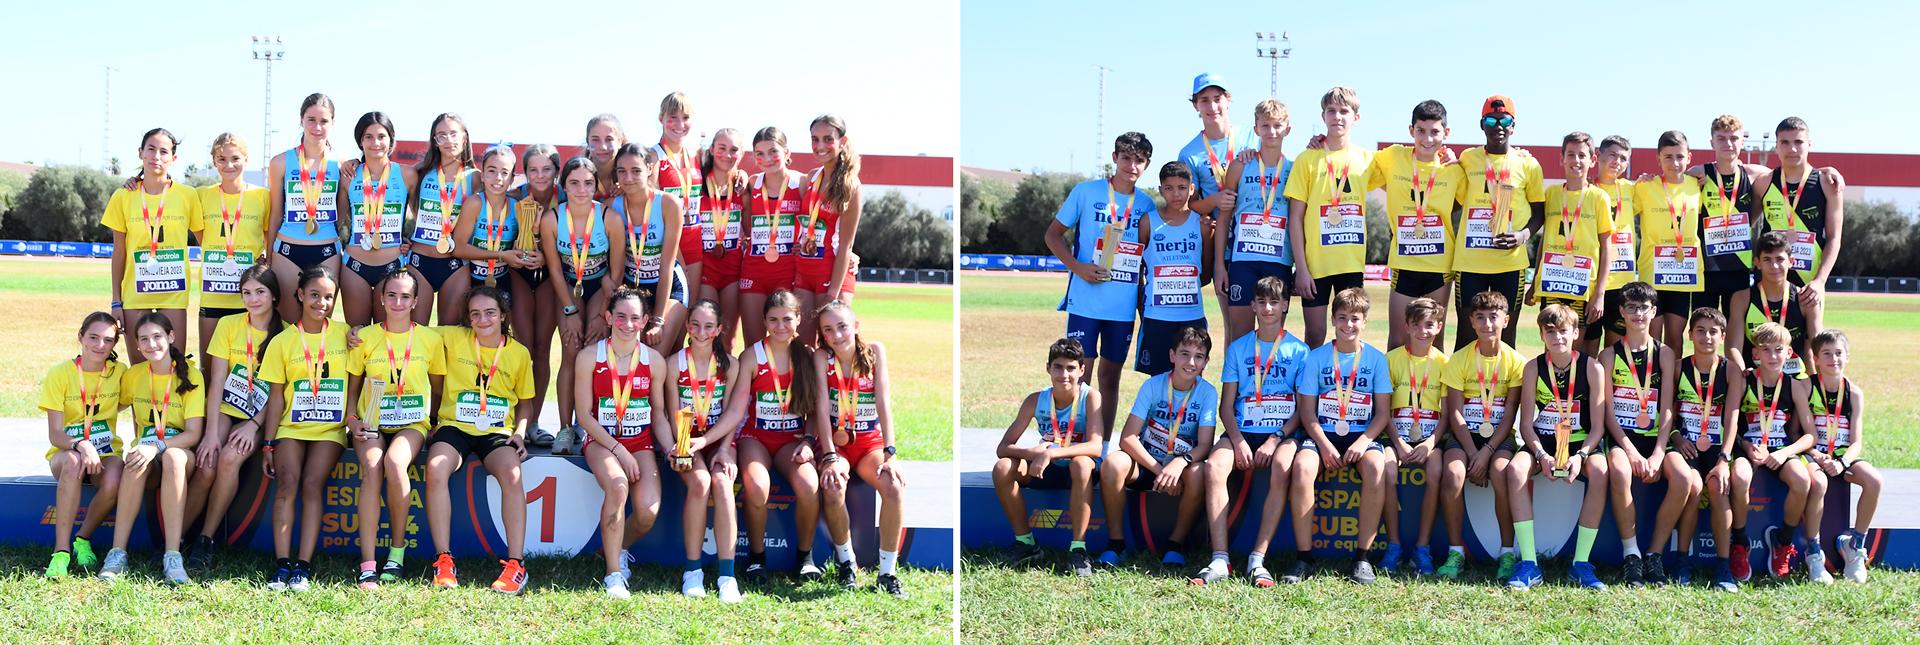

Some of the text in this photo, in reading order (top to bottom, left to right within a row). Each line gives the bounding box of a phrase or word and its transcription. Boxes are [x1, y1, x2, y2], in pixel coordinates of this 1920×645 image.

[781, 230, 793, 241] 2023
[1430, 230, 1441, 239] 2023
[1736, 227, 1748, 237] 2023
[1155, 239, 1196, 253] nerja
[1684, 260, 1695, 270] 2023
[1545, 267, 1587, 281] TORREVIEJA 2023
[1157, 280, 1186, 290] TORREVIEJA
[327, 396, 340, 405] 2023
[491, 409, 506, 419] 2023
[1278, 404, 1291, 415] 2023
[1353, 407, 1366, 418] 2023
[407, 411, 421, 420] 2023
[636, 411, 648, 420] 2023
[526, 476, 557, 543] 1
[323, 536, 351, 549] por
